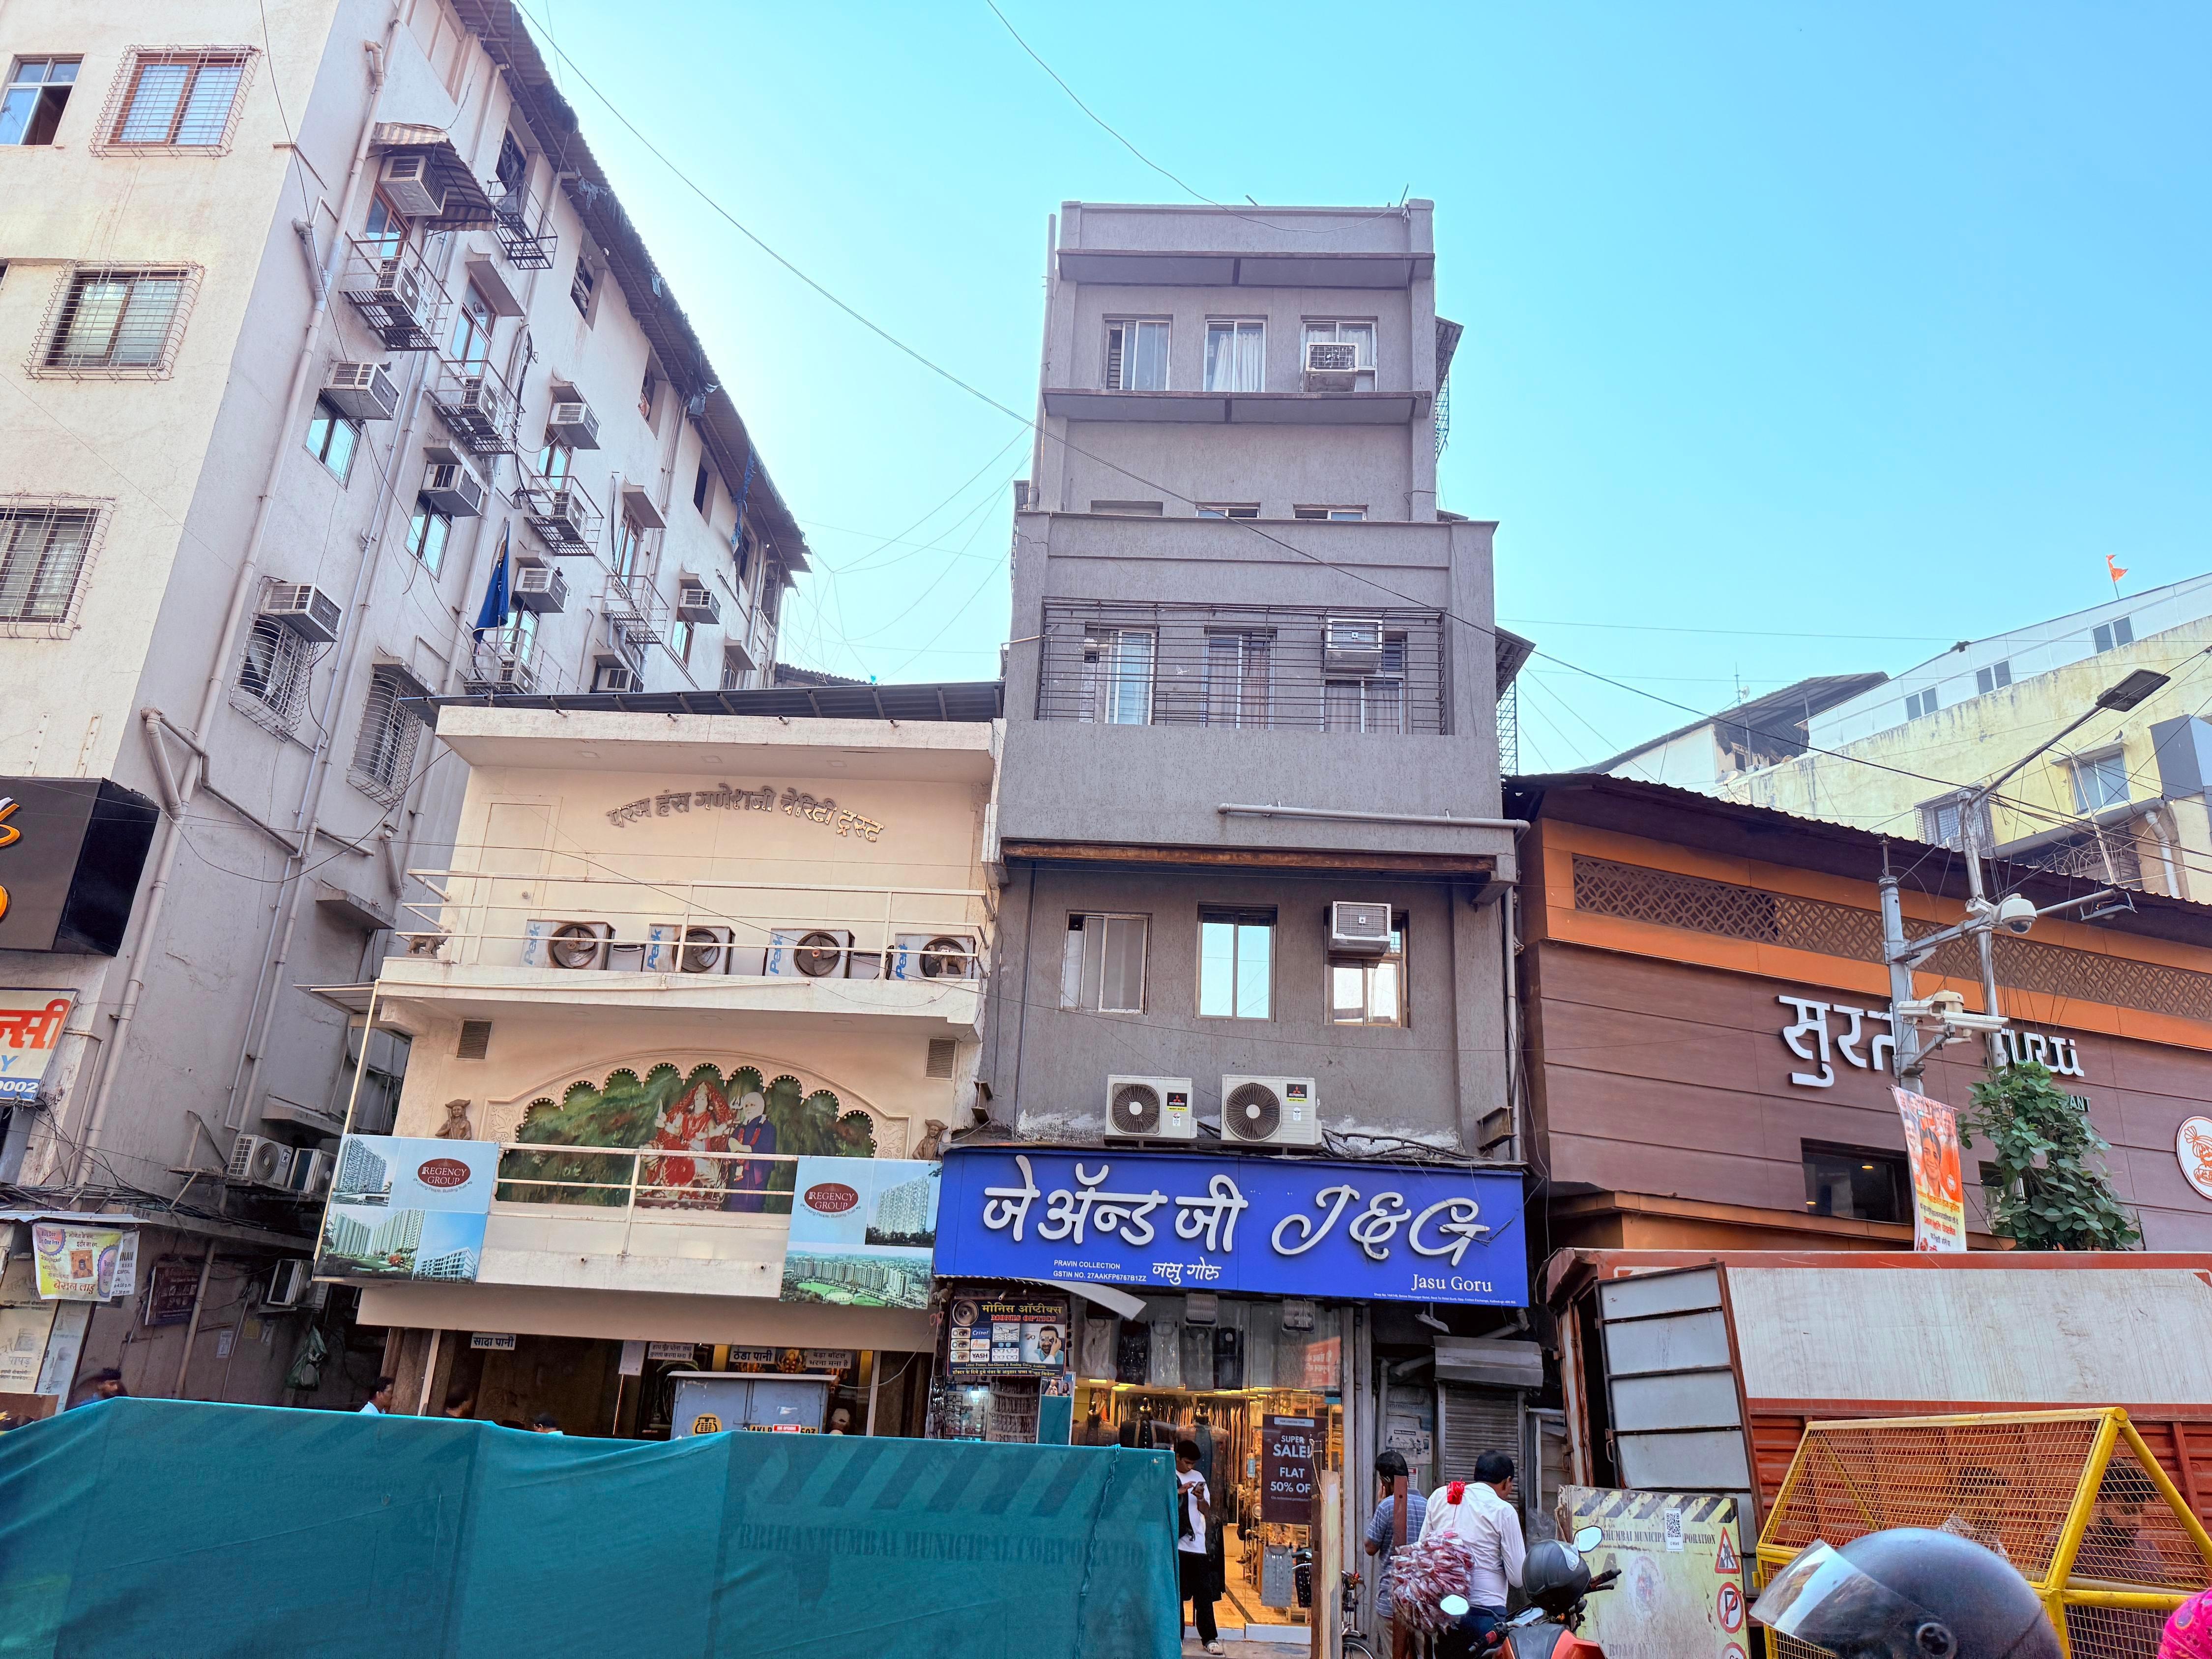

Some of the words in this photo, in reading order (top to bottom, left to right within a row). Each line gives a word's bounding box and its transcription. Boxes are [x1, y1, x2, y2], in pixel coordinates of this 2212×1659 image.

[606, 797, 651, 828] परम
[655, 789, 691, 816] हंस
[837, 809, 884, 842] ट्रस्ट
[1779, 995, 1896, 1087] सुरत
[422, 1166, 466, 1176] REGENCY
[428, 1176, 460, 1185] GROUP
[809, 1192, 854, 1201] REGENCY
[815, 1201, 848, 1210] GROUP
[983, 1155, 1041, 1241] जे
[1175, 1174, 1249, 1252] जी
[1079, 1261, 1120, 1270] COLLECTION
[1152, 1262, 1183, 1285] जसु
[54, 1280, 77, 1290] बेसन
[1411, 1274, 1446, 1291] Jasu
[1451, 1276, 1492, 1292] Goru
[981, 1302, 1015, 1313] मोनिस
[473, 1337, 493, 1347] सादा
[495, 1336, 514, 1347] पानी
[734, 1348, 750, 1360] ठंडा
[753, 1350, 772, 1361] पानी
[1273, 1444, 1311, 1458] SALE!
[1280, 1467, 1305, 1478] FLAT
[1271, 1481, 1293, 1492] 50%
[1296, 1483, 1311, 1493] OF
[1602, 1529, 1632, 1541] NMUMBAI
[1634, 1531, 1665, 1542] MUNICIPA
[1683, 1533, 1716, 1544] PORATION
